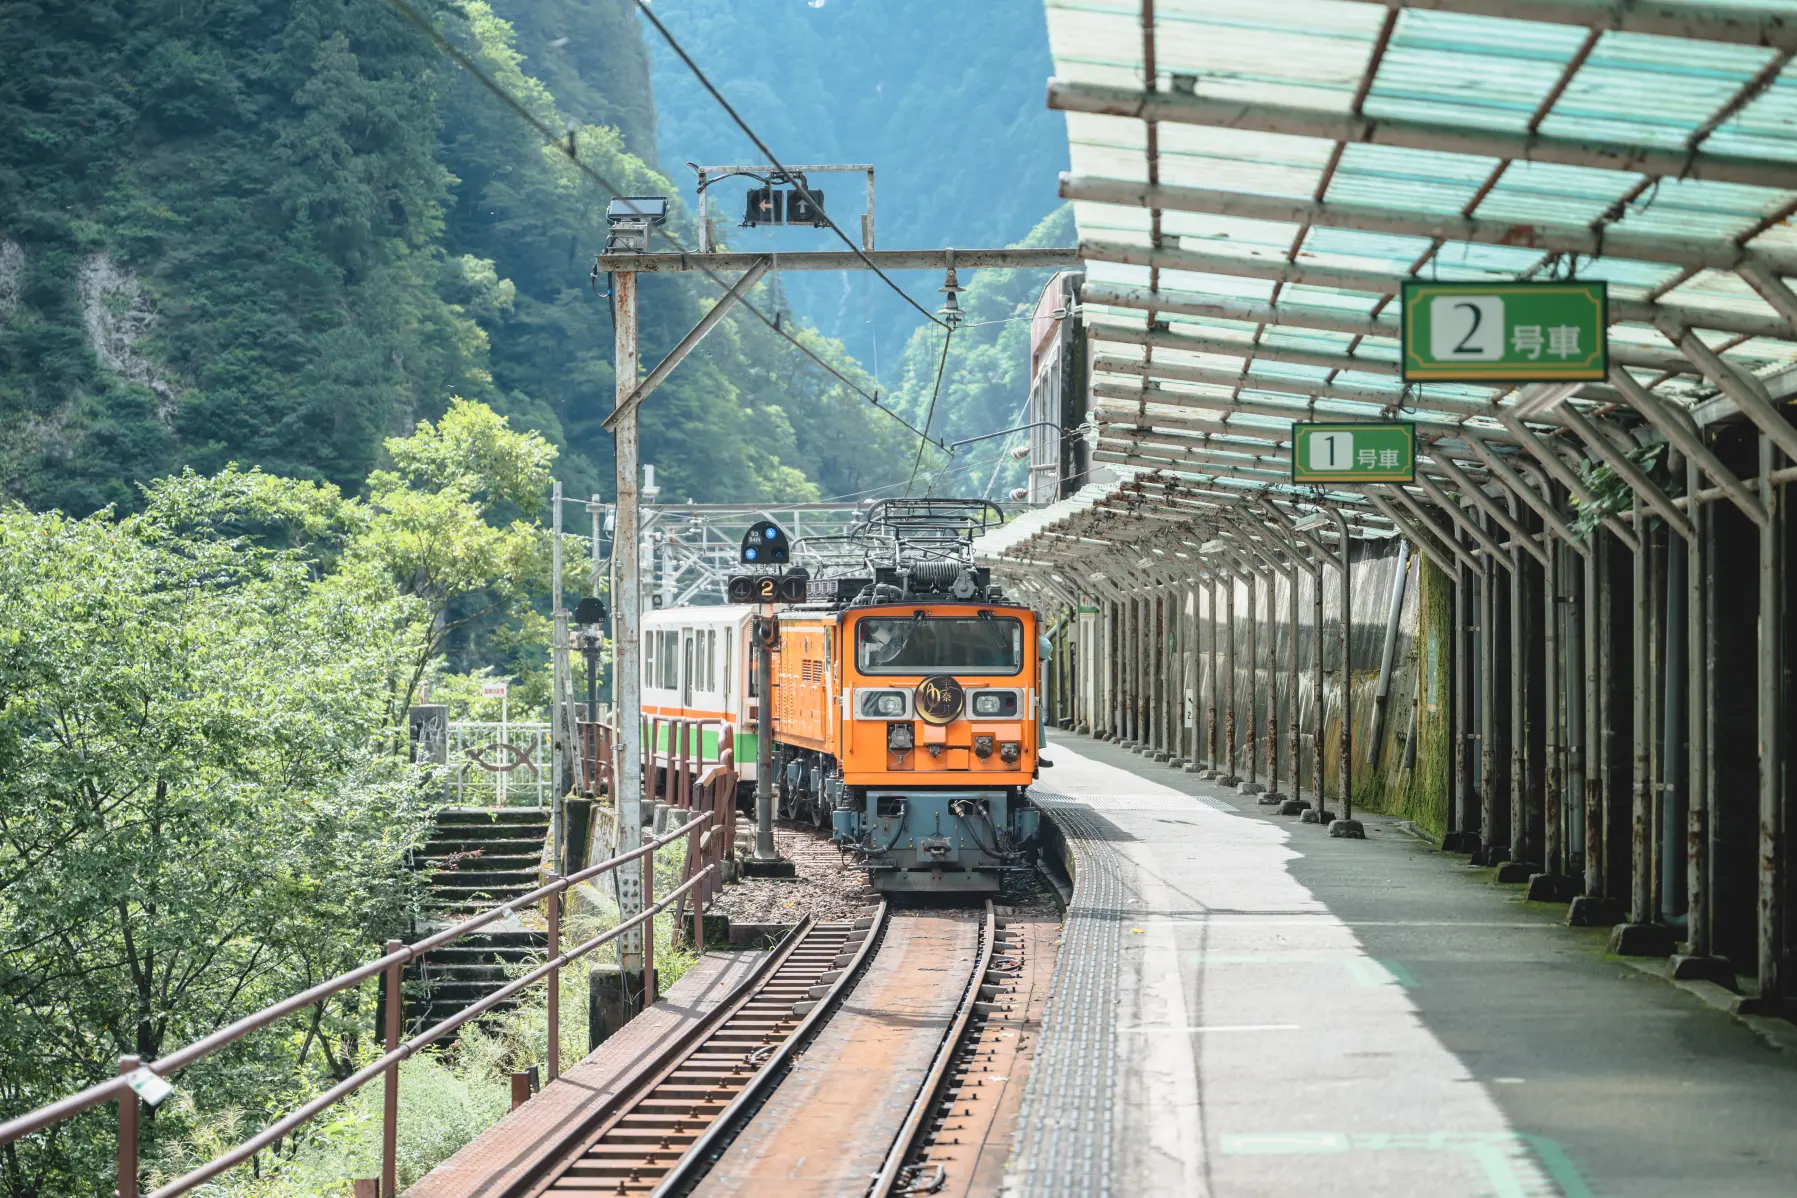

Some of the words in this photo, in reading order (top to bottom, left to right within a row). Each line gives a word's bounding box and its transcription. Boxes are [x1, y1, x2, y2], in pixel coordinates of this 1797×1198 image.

[1452, 302, 1484, 354] 2
[1510, 324, 1581, 360] 号車
[1324, 435, 1335, 467] 1
[1357, 448, 1400, 470] 号車
[734, 581, 747, 596] 4
[761, 580, 774, 596] 2
